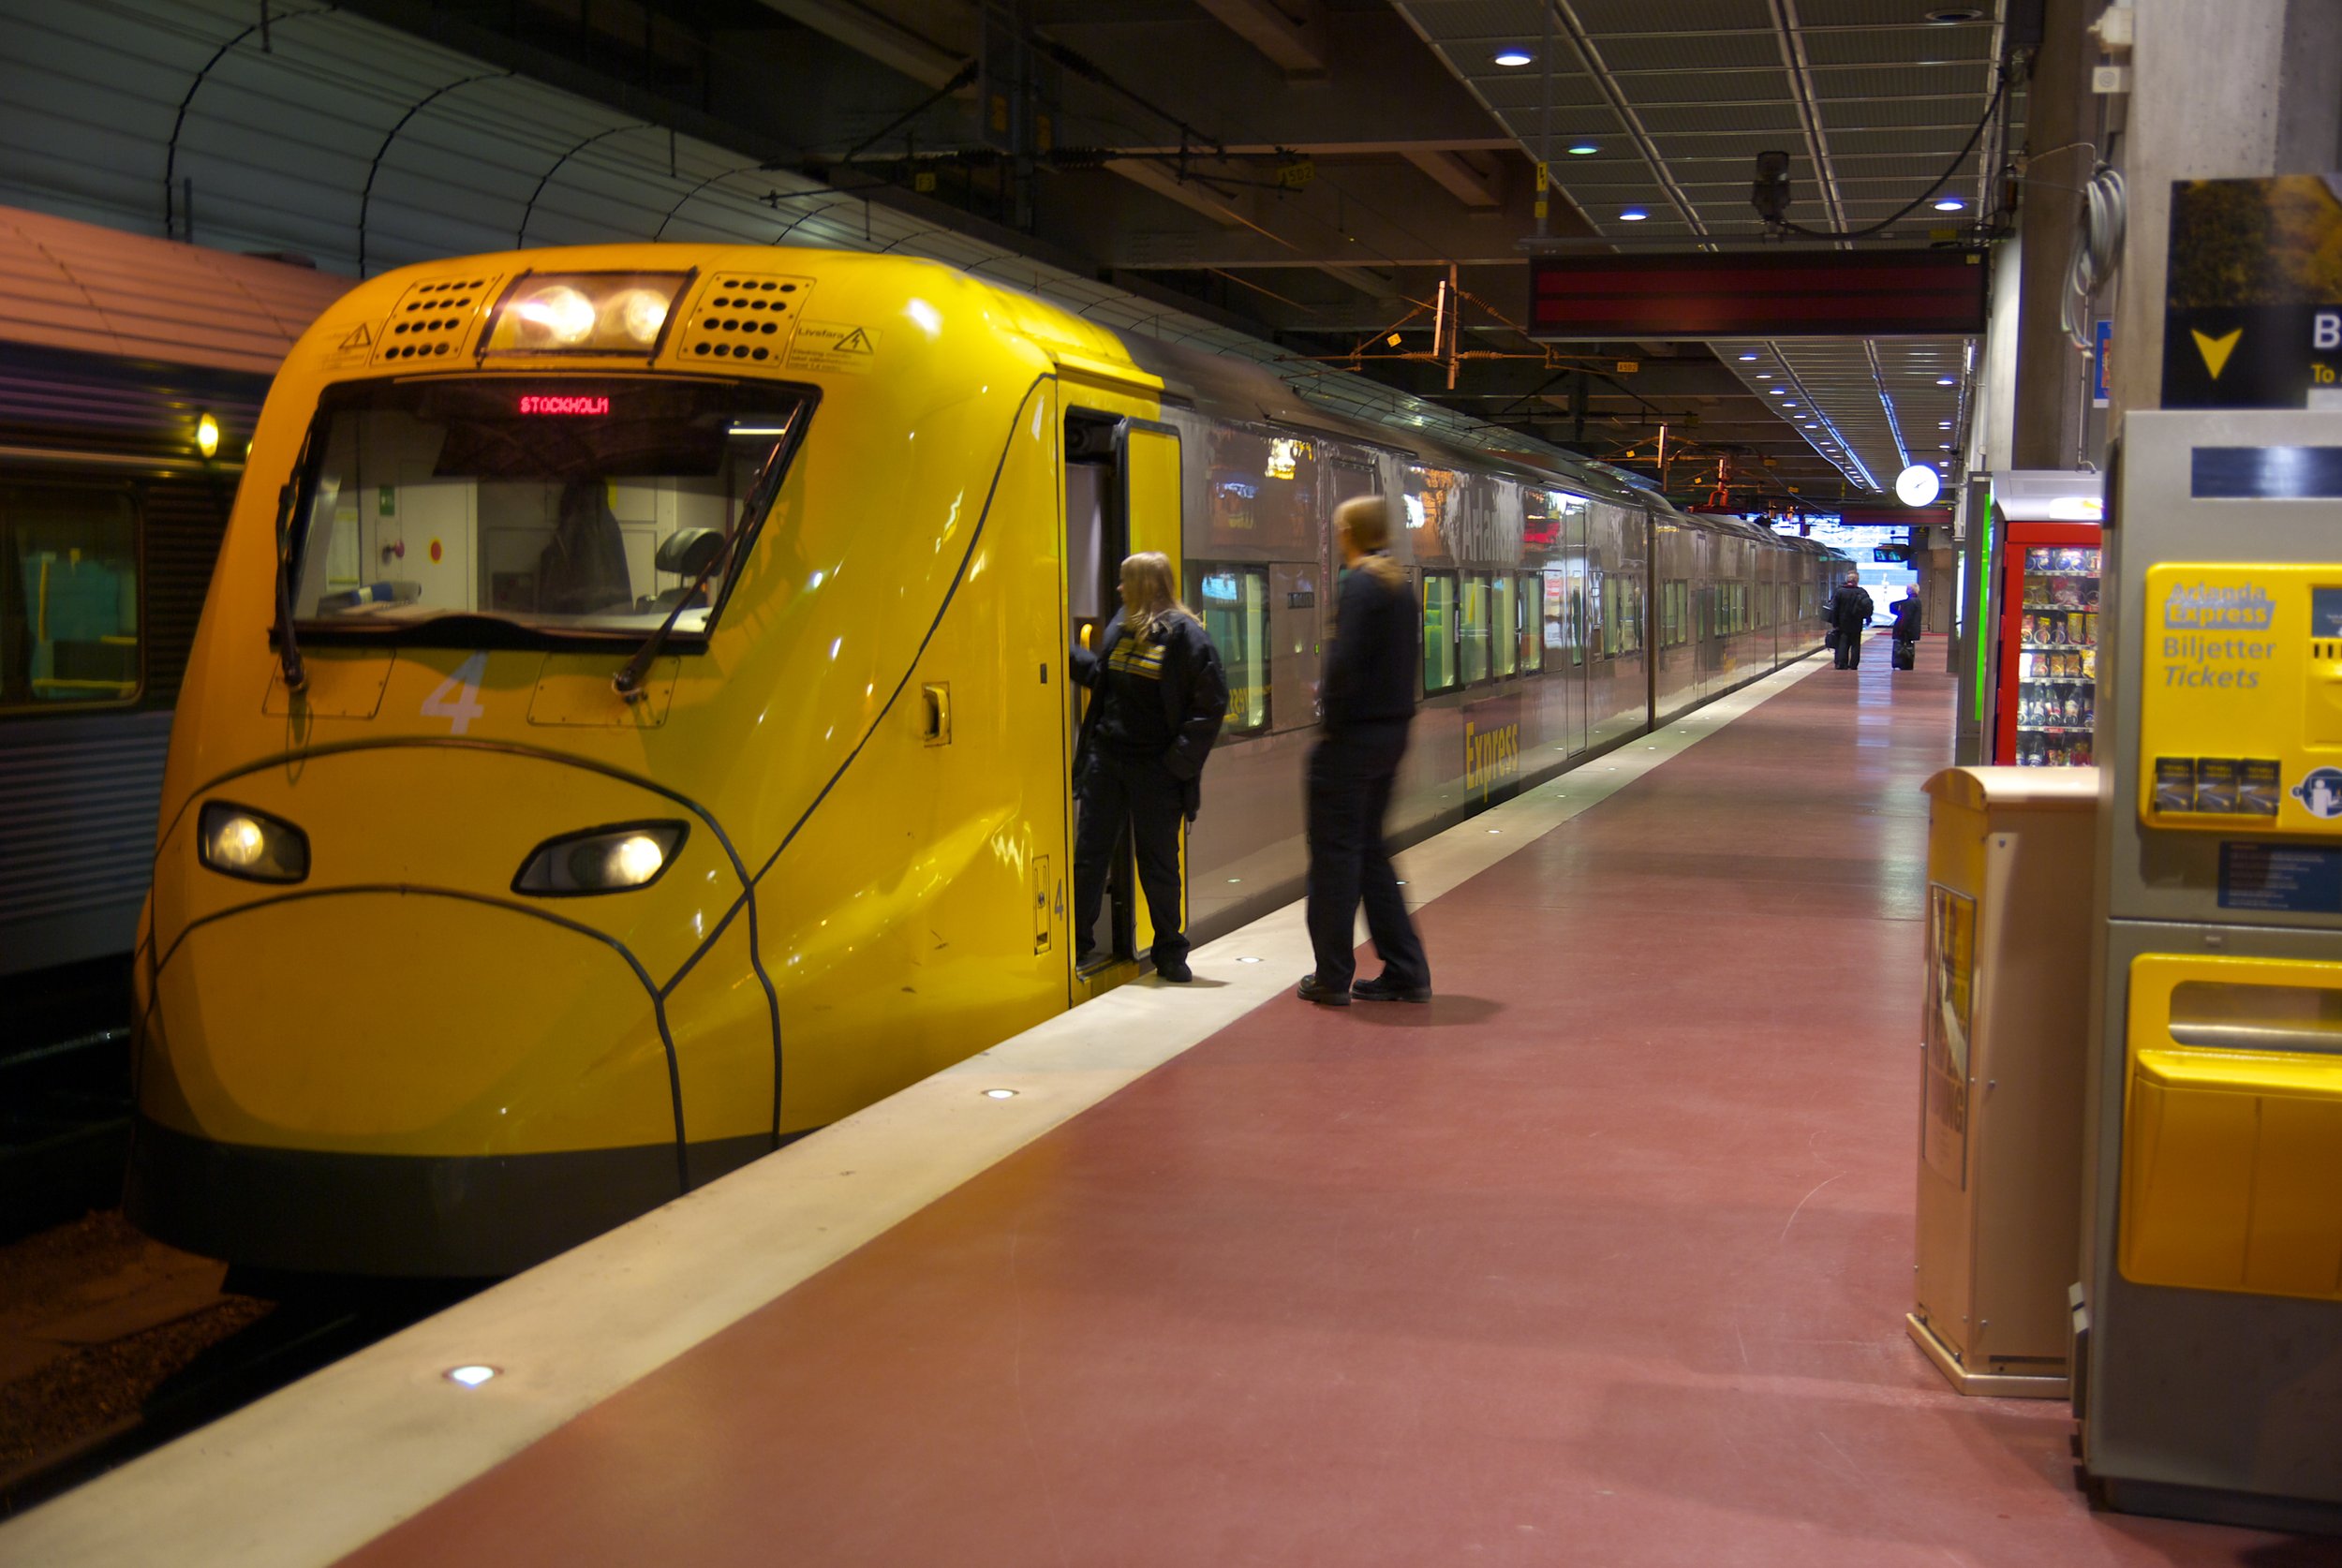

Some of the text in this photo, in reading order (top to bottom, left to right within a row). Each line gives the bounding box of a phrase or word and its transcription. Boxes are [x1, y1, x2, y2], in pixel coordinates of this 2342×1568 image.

[2311, 363, 2335, 384] To
[520, 396, 610, 414] STOCKHOLM
[2168, 582, 2267, 602] Arlanda
[2170, 604, 2268, 627] Express
[2164, 636, 2277, 664] Biljetter
[2164, 665, 2260, 688] Tickets
[420, 650, 490, 735] 4
[1466, 721, 1518, 803] Express
[1054, 879, 1064, 922] 4
